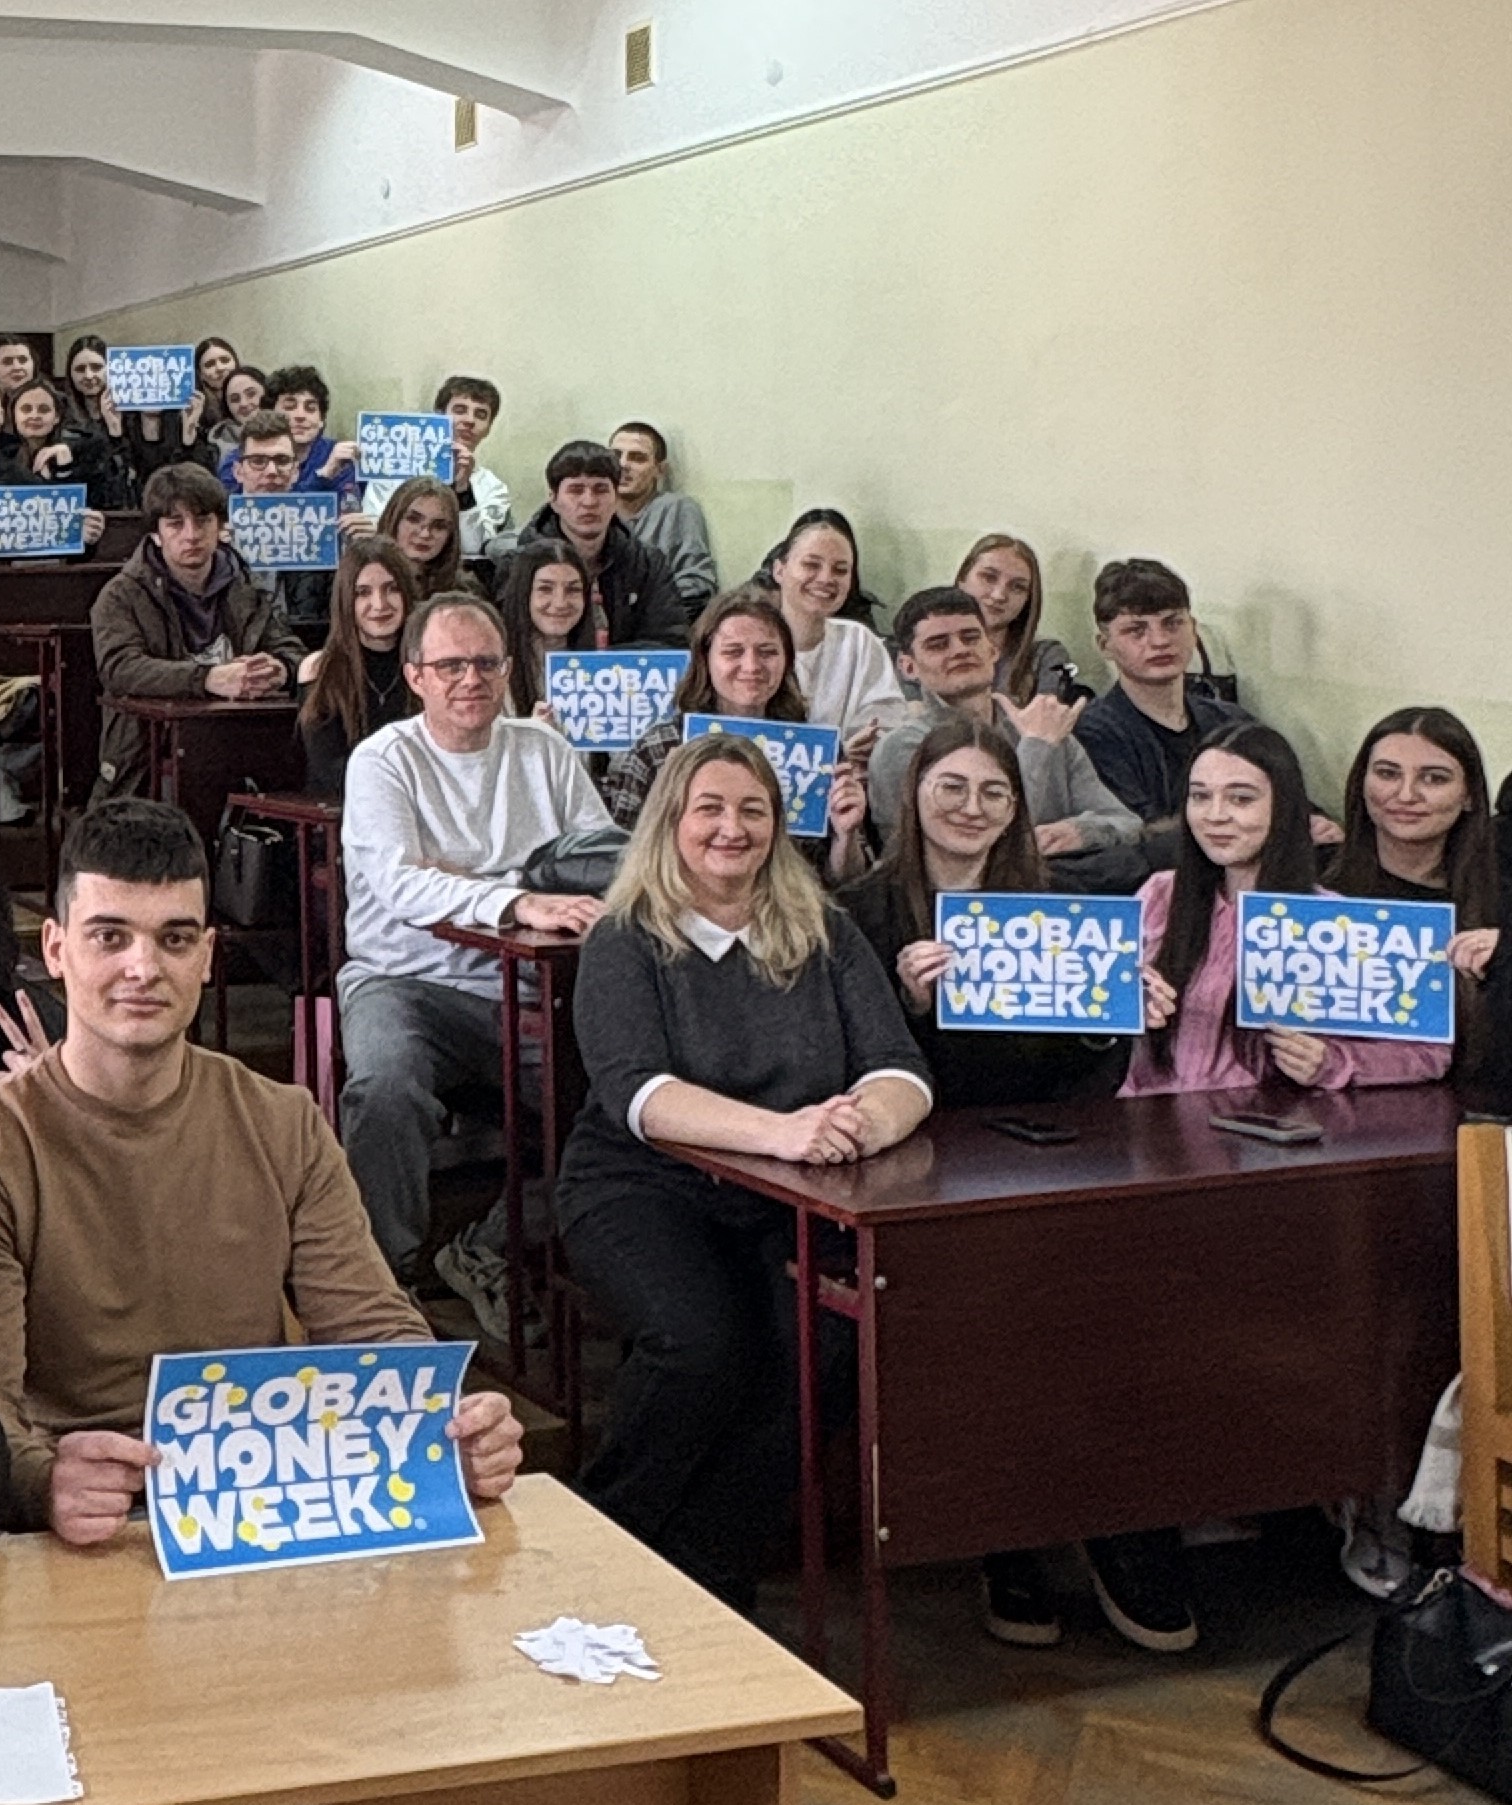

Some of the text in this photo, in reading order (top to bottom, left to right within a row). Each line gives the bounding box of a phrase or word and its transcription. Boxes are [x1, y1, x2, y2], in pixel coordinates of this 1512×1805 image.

[110, 356, 192, 374] GLOBAL
[111, 372, 184, 390] MONEY
[361, 423, 452, 444] GLOBAL
[361, 440, 442, 460] MONEY
[232, 506, 336, 526] GLOBAL
[235, 524, 325, 544] MONEY
[552, 692, 675, 719] MONEY
[943, 914, 1137, 953] GLOBAL
[1245, 915, 1447, 961] GLOBAL
[944, 948, 1118, 984] MONEY
[1245, 950, 1429, 991] MONEY
[943, 981, 1089, 1020] WEEK
[1244, 979, 1395, 1025] WEEK
[157, 1366, 451, 1436] GLOBAL
[156, 1412, 424, 1496] MONEY
[158, 1474, 394, 1555] WEEK
